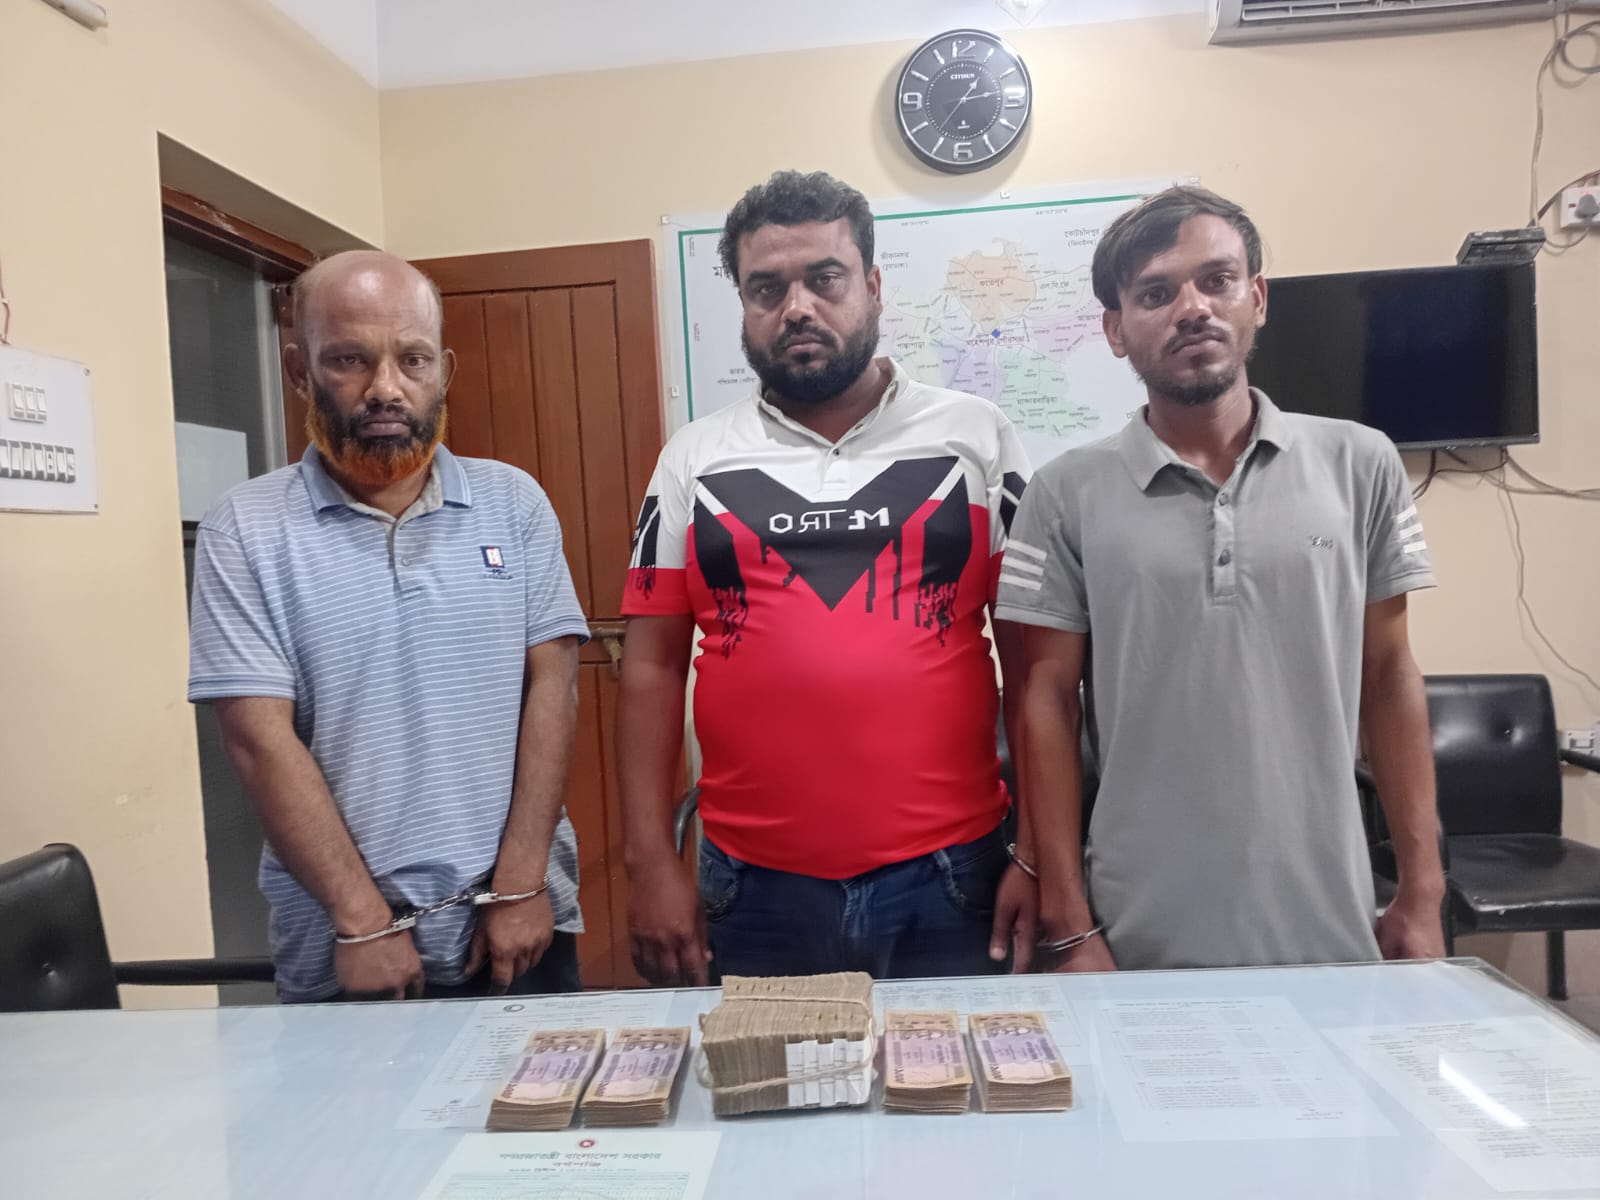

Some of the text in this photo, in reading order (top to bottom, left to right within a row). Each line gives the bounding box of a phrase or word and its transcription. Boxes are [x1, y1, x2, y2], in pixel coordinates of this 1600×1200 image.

[952, 40, 976, 58] 12
[903, 92, 922, 112] 9
[953, 142, 973, 160] 6
